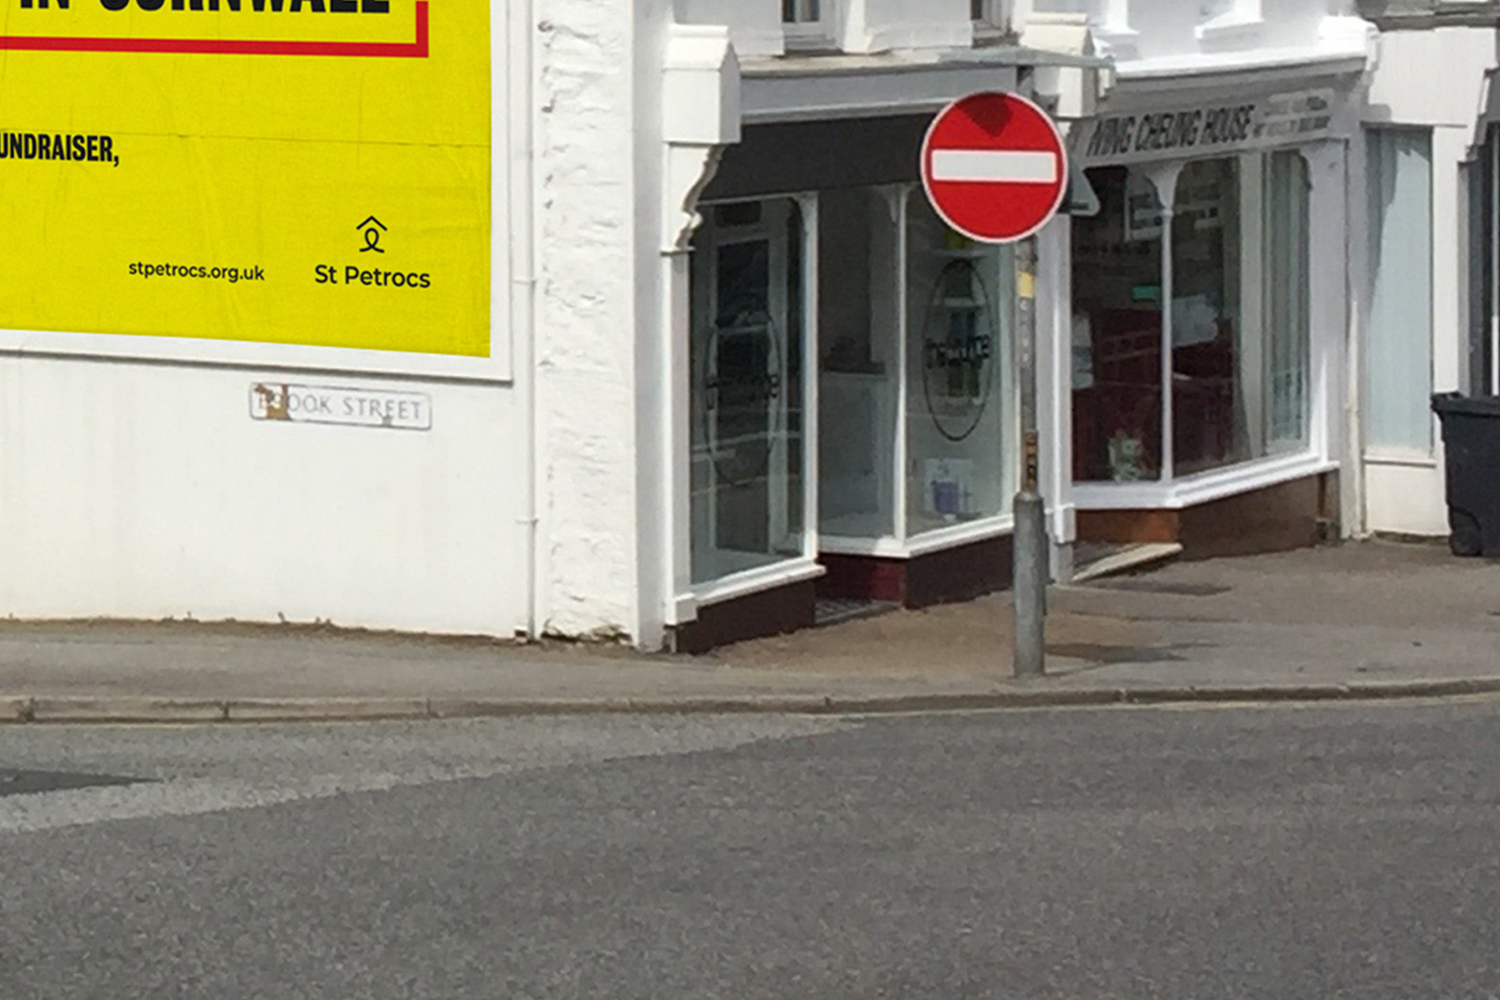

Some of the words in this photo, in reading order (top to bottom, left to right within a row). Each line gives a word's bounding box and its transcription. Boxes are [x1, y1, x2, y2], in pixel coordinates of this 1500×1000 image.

[129, 261, 265, 284] stpetrocs.org.uk
[315, 263, 337, 285] St
[345, 265, 431, 289] Petrocs
[343, 397, 422, 419] STREET
